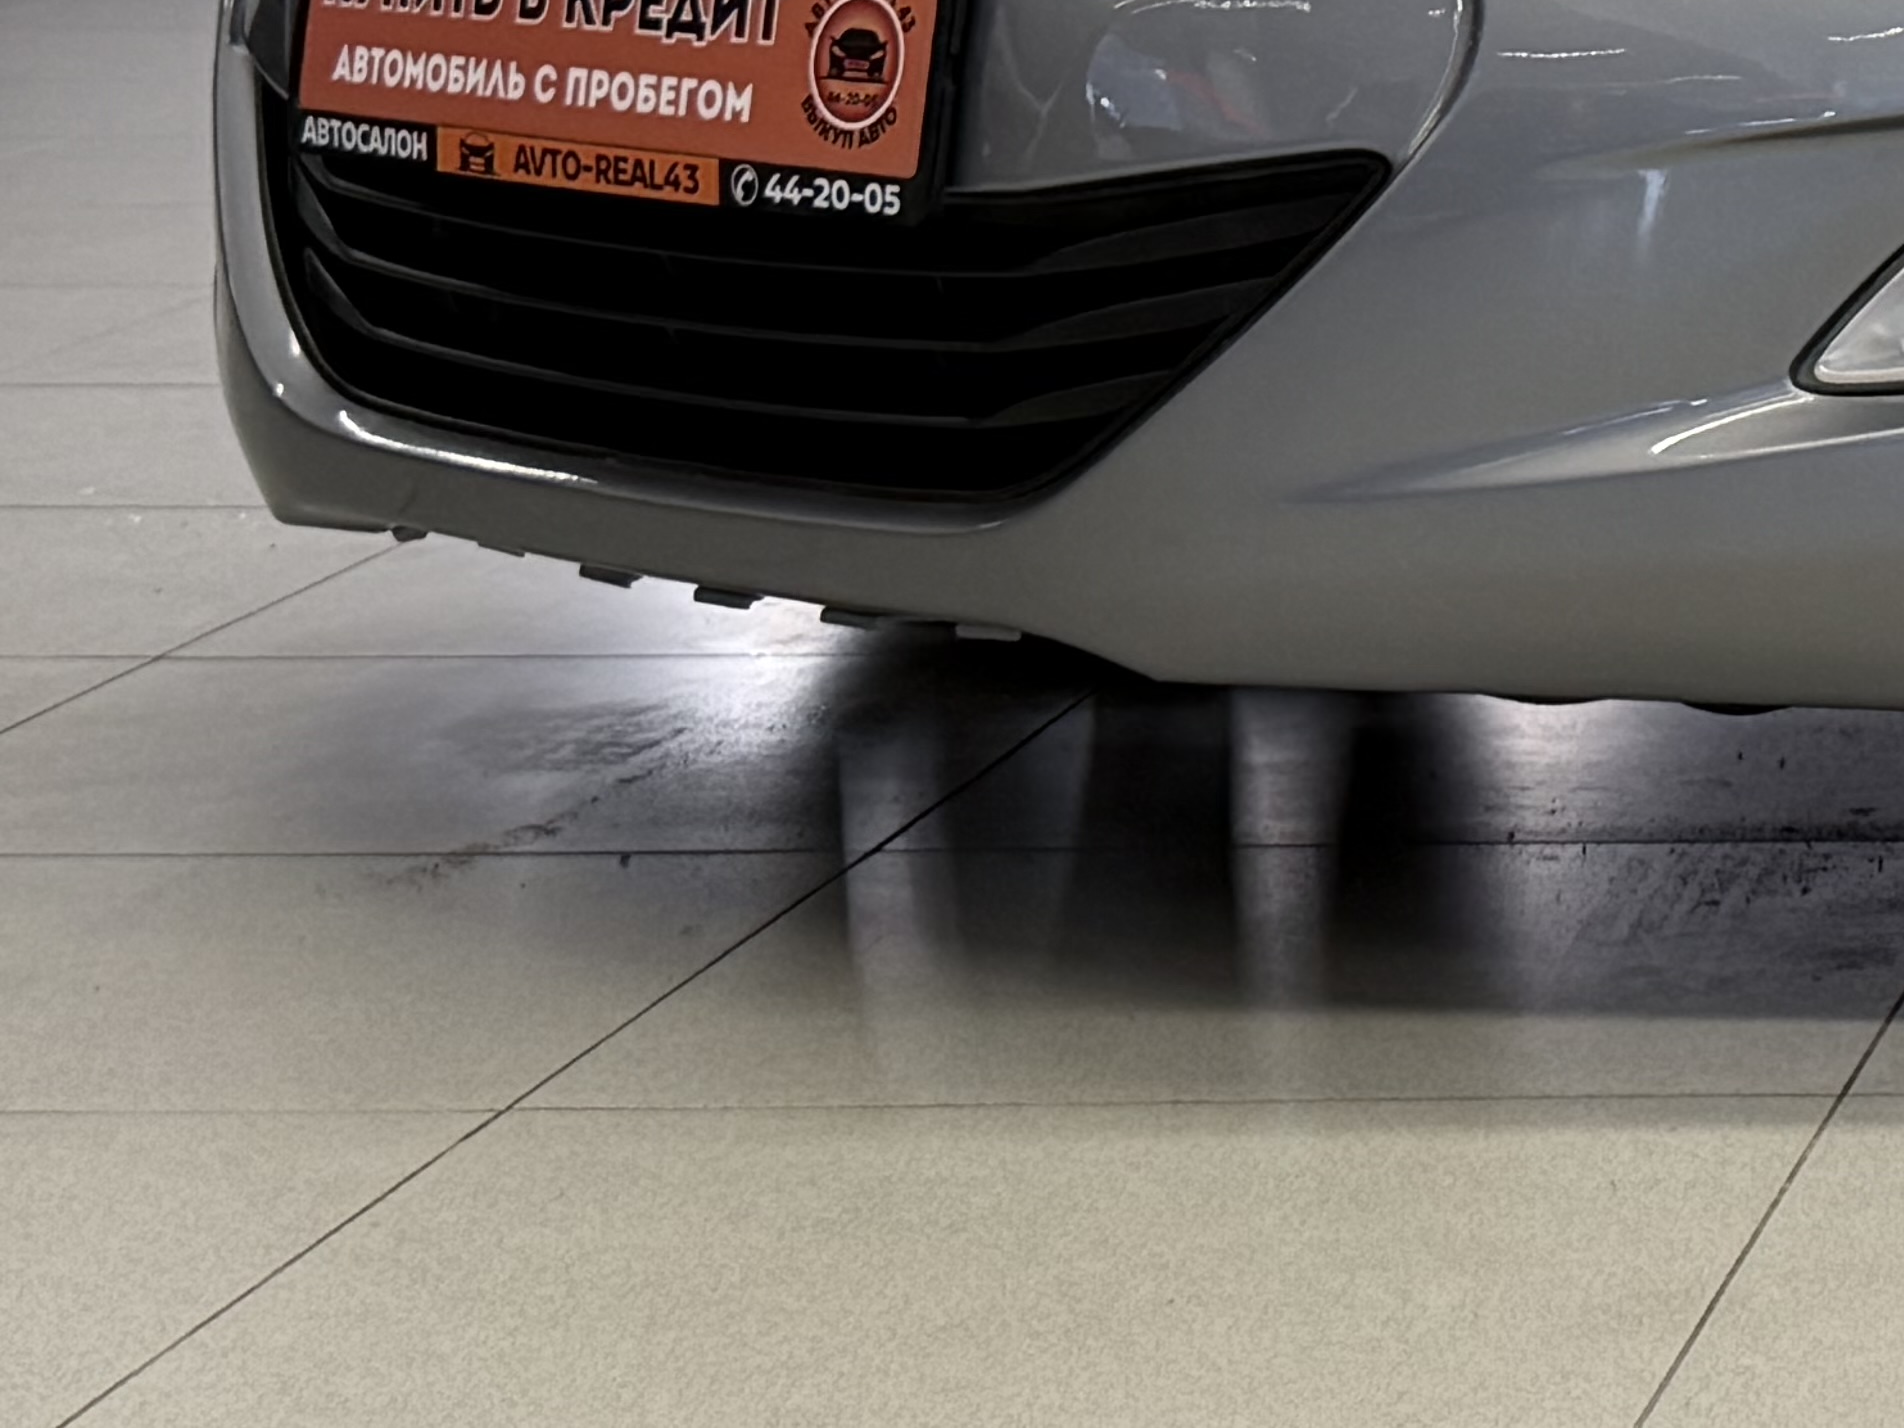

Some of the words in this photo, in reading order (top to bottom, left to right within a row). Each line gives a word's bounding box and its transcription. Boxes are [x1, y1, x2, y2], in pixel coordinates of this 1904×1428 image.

[331, 43, 526, 101] АВТОМОБИЛЬ
[534, 65, 557, 102] С
[565, 67, 753, 124] ПРОБЕГОМ
[301, 115, 428, 162] АВТОСАЛОН
[512, 144, 700, 195] AVTO-REAL43
[763, 177, 902, 217] 44-20-05
